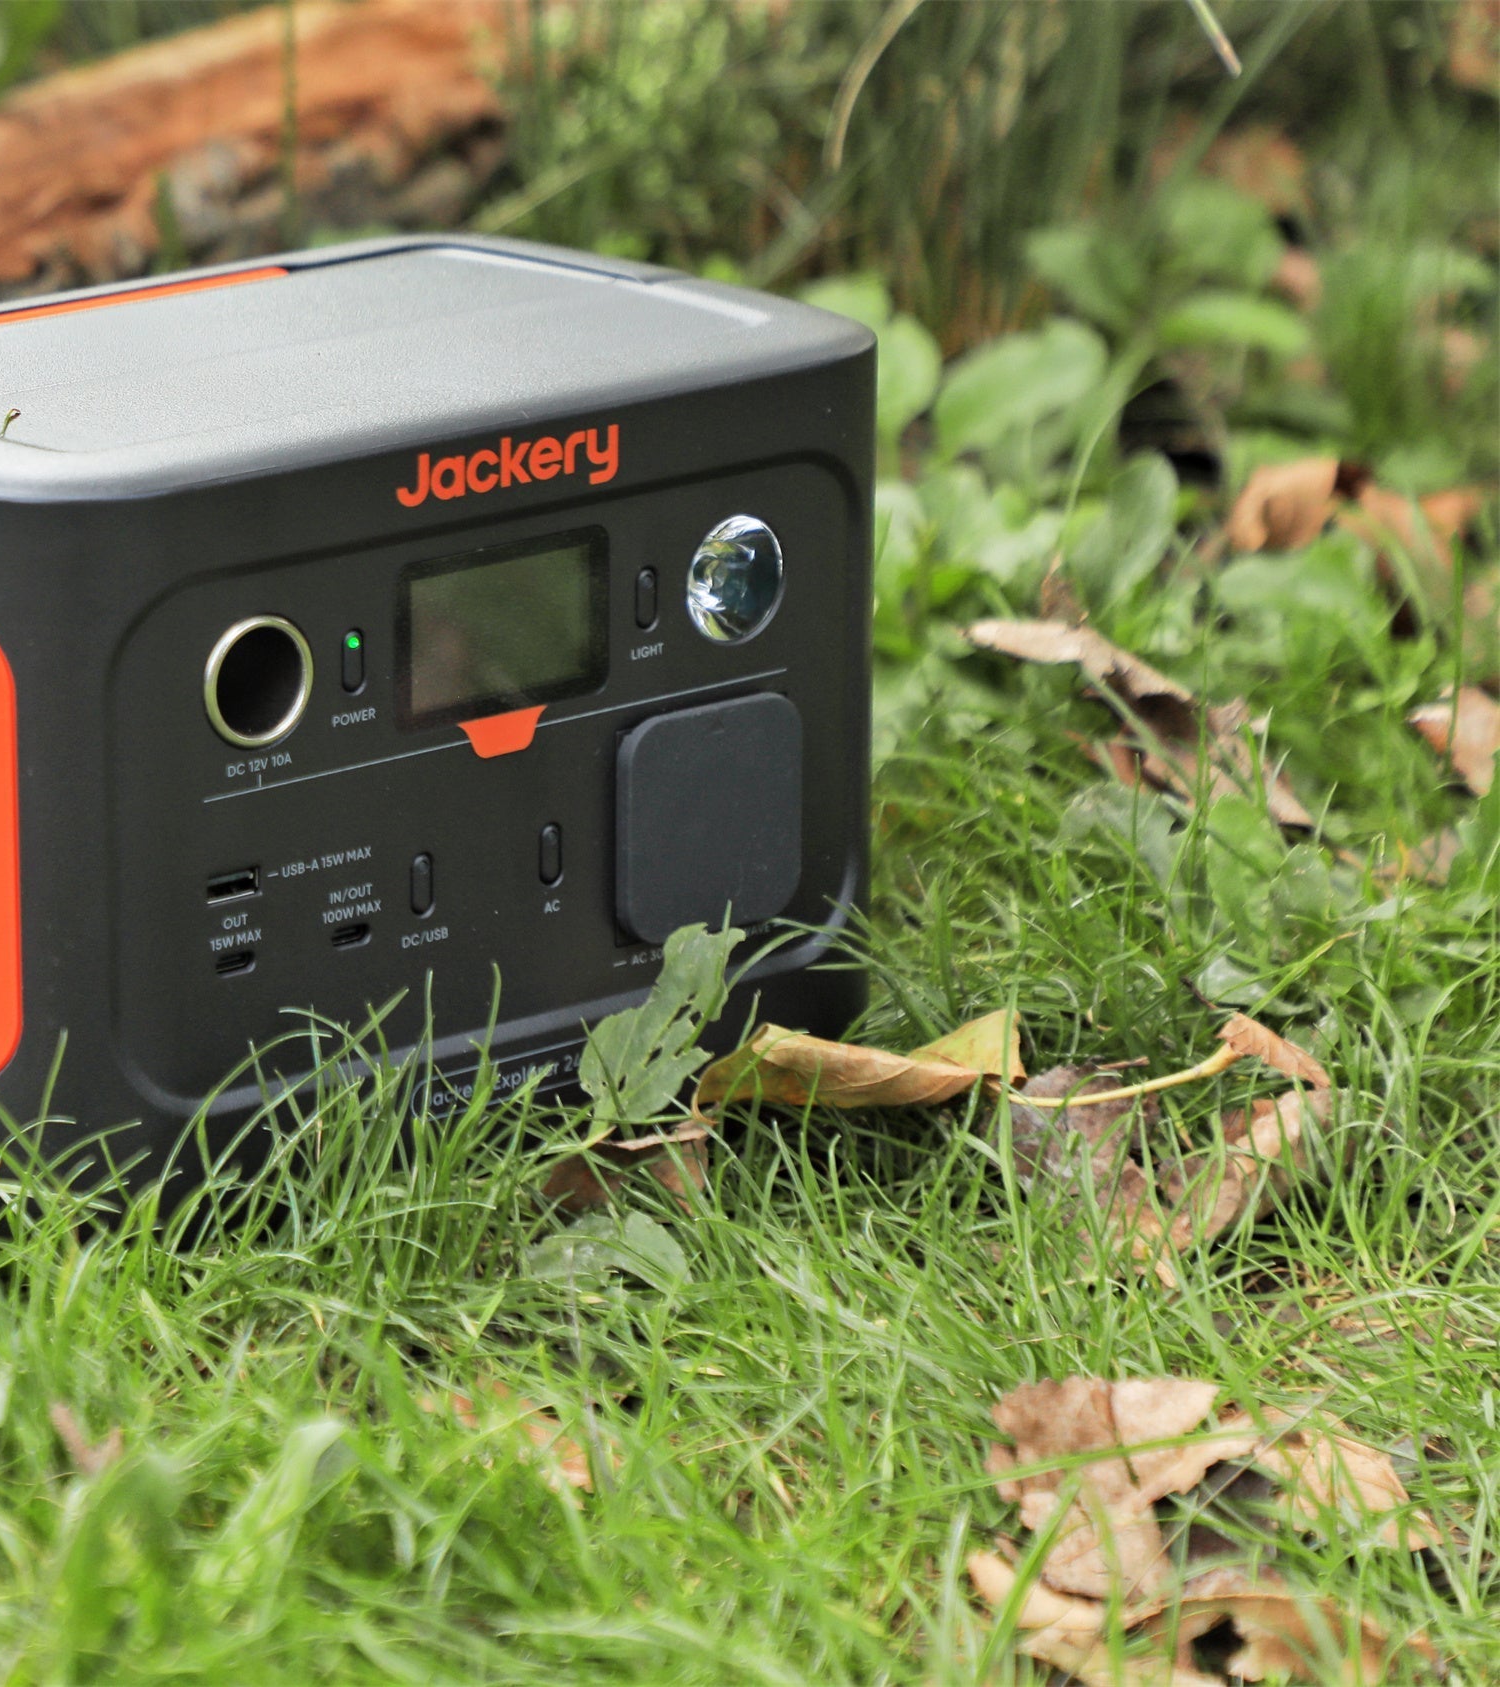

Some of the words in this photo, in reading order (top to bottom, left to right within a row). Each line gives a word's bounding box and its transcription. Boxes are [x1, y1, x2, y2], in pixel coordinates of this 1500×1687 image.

[395, 424, 619, 508] Jackery
[630, 642, 664, 661] LIGHT
[332, 707, 376, 728] POWER
[227, 763, 246, 778] DC
[248, 757, 268, 773] 12V
[271, 752, 293, 768] 10A
[282, 858, 319, 878] USB-A
[321, 852, 345, 869] 15W
[346, 846, 372, 862] MAX
[329, 882, 373, 904] IN/OUT
[322, 906, 355, 924] 100W
[355, 900, 382, 917] MAX
[543, 899, 561, 914] AC
[222, 913, 249, 930] OUT
[209, 935, 235, 952] 15W
[235, 929, 263, 946] MAX
[401, 926, 450, 949] DC/USB
[630, 951, 648, 966] AC
